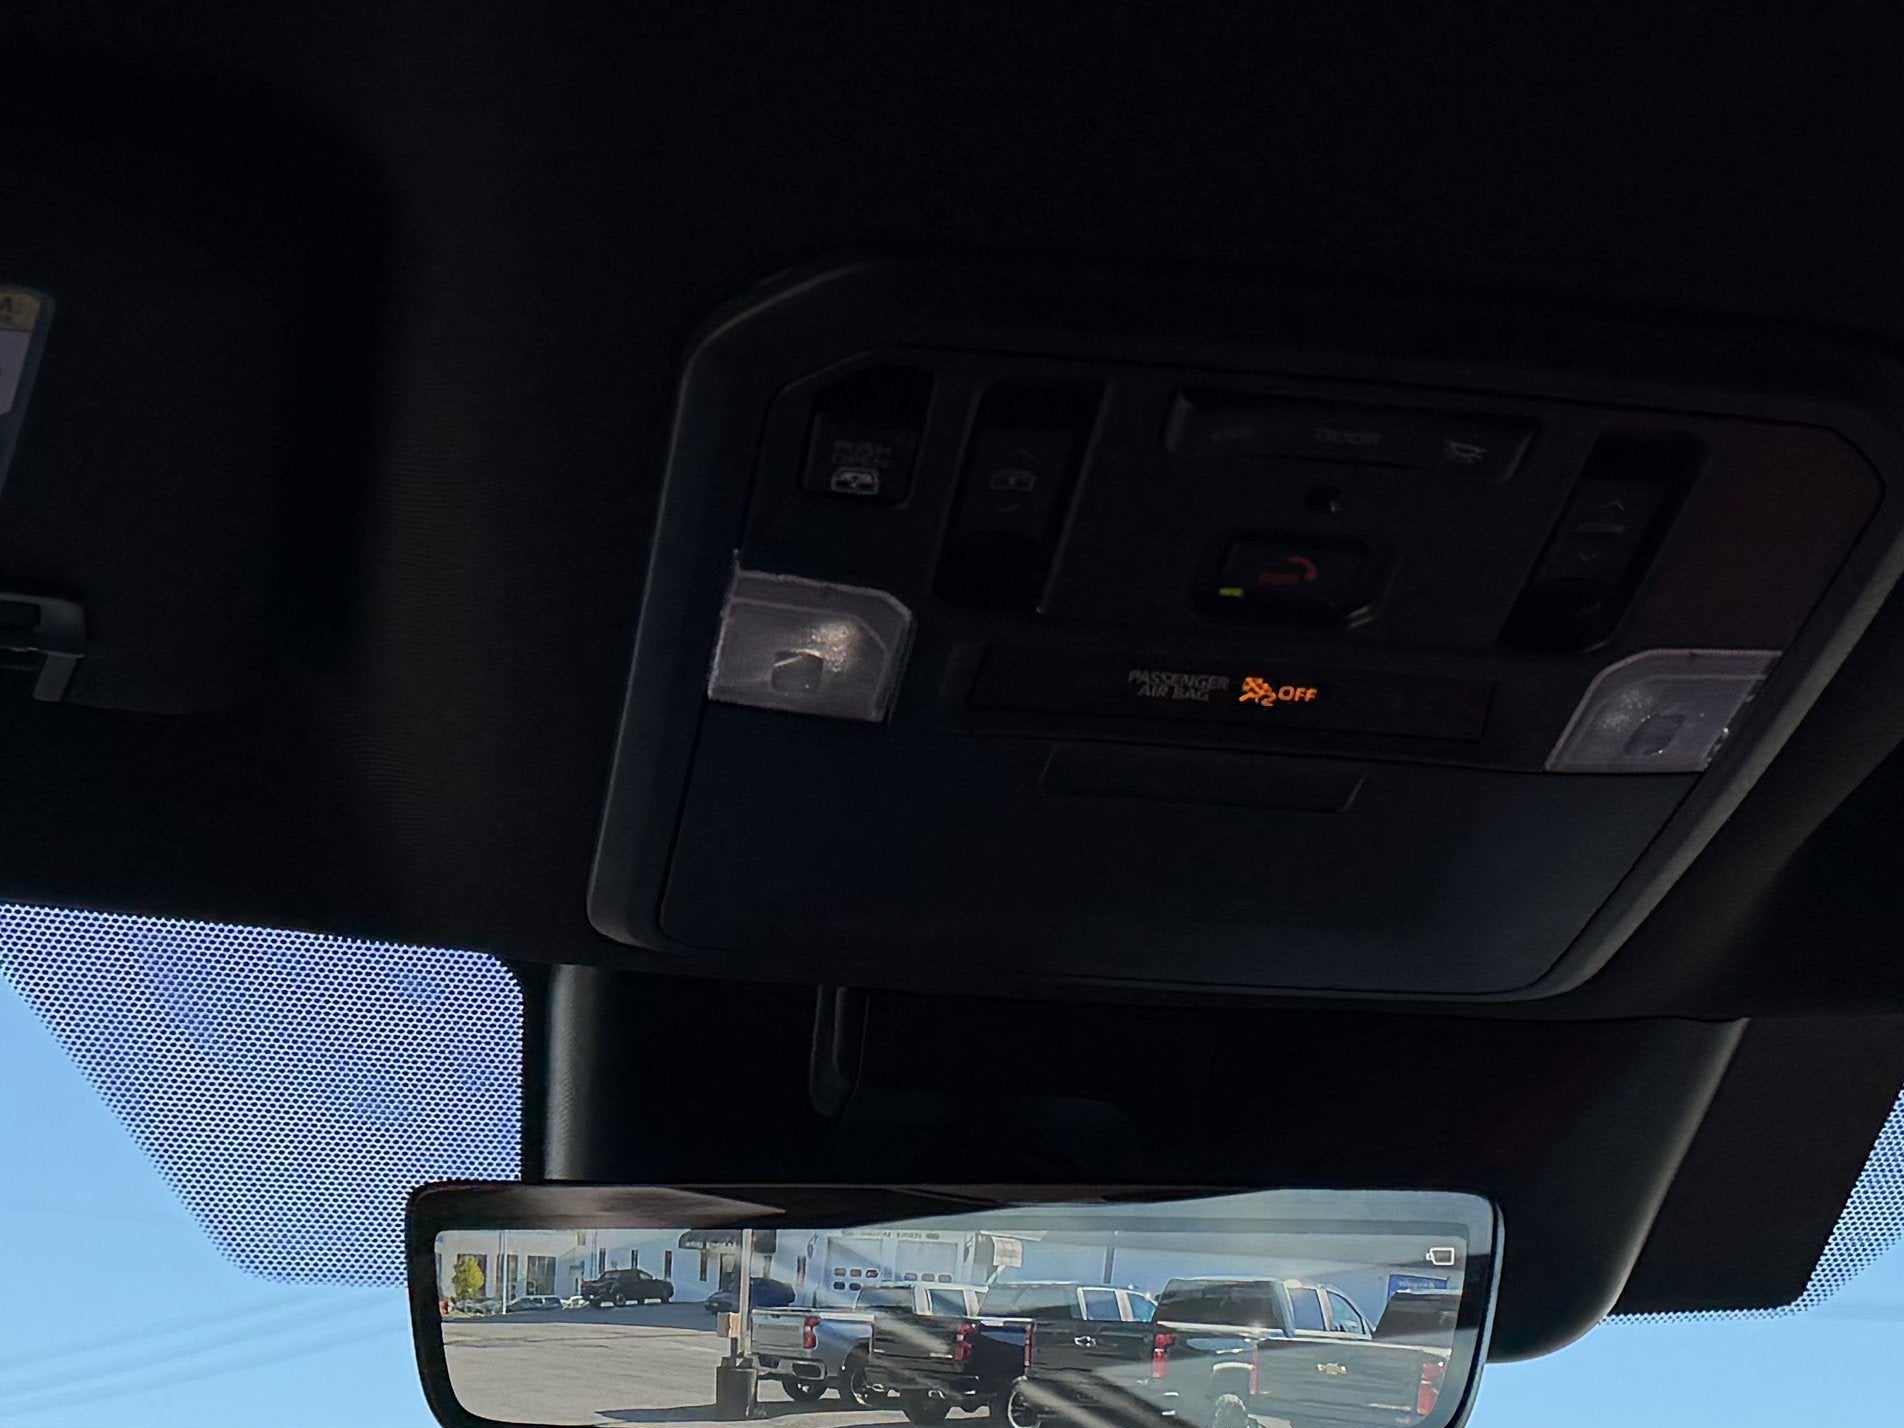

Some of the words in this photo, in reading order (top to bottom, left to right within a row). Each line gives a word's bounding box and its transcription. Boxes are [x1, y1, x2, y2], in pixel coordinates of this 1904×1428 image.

[1128, 668, 1230, 689] PASSENGER
[1137, 683, 1167, 698] AIR
[1171, 686, 1209, 701] BAG
[1277, 685, 1318, 702] OFF
